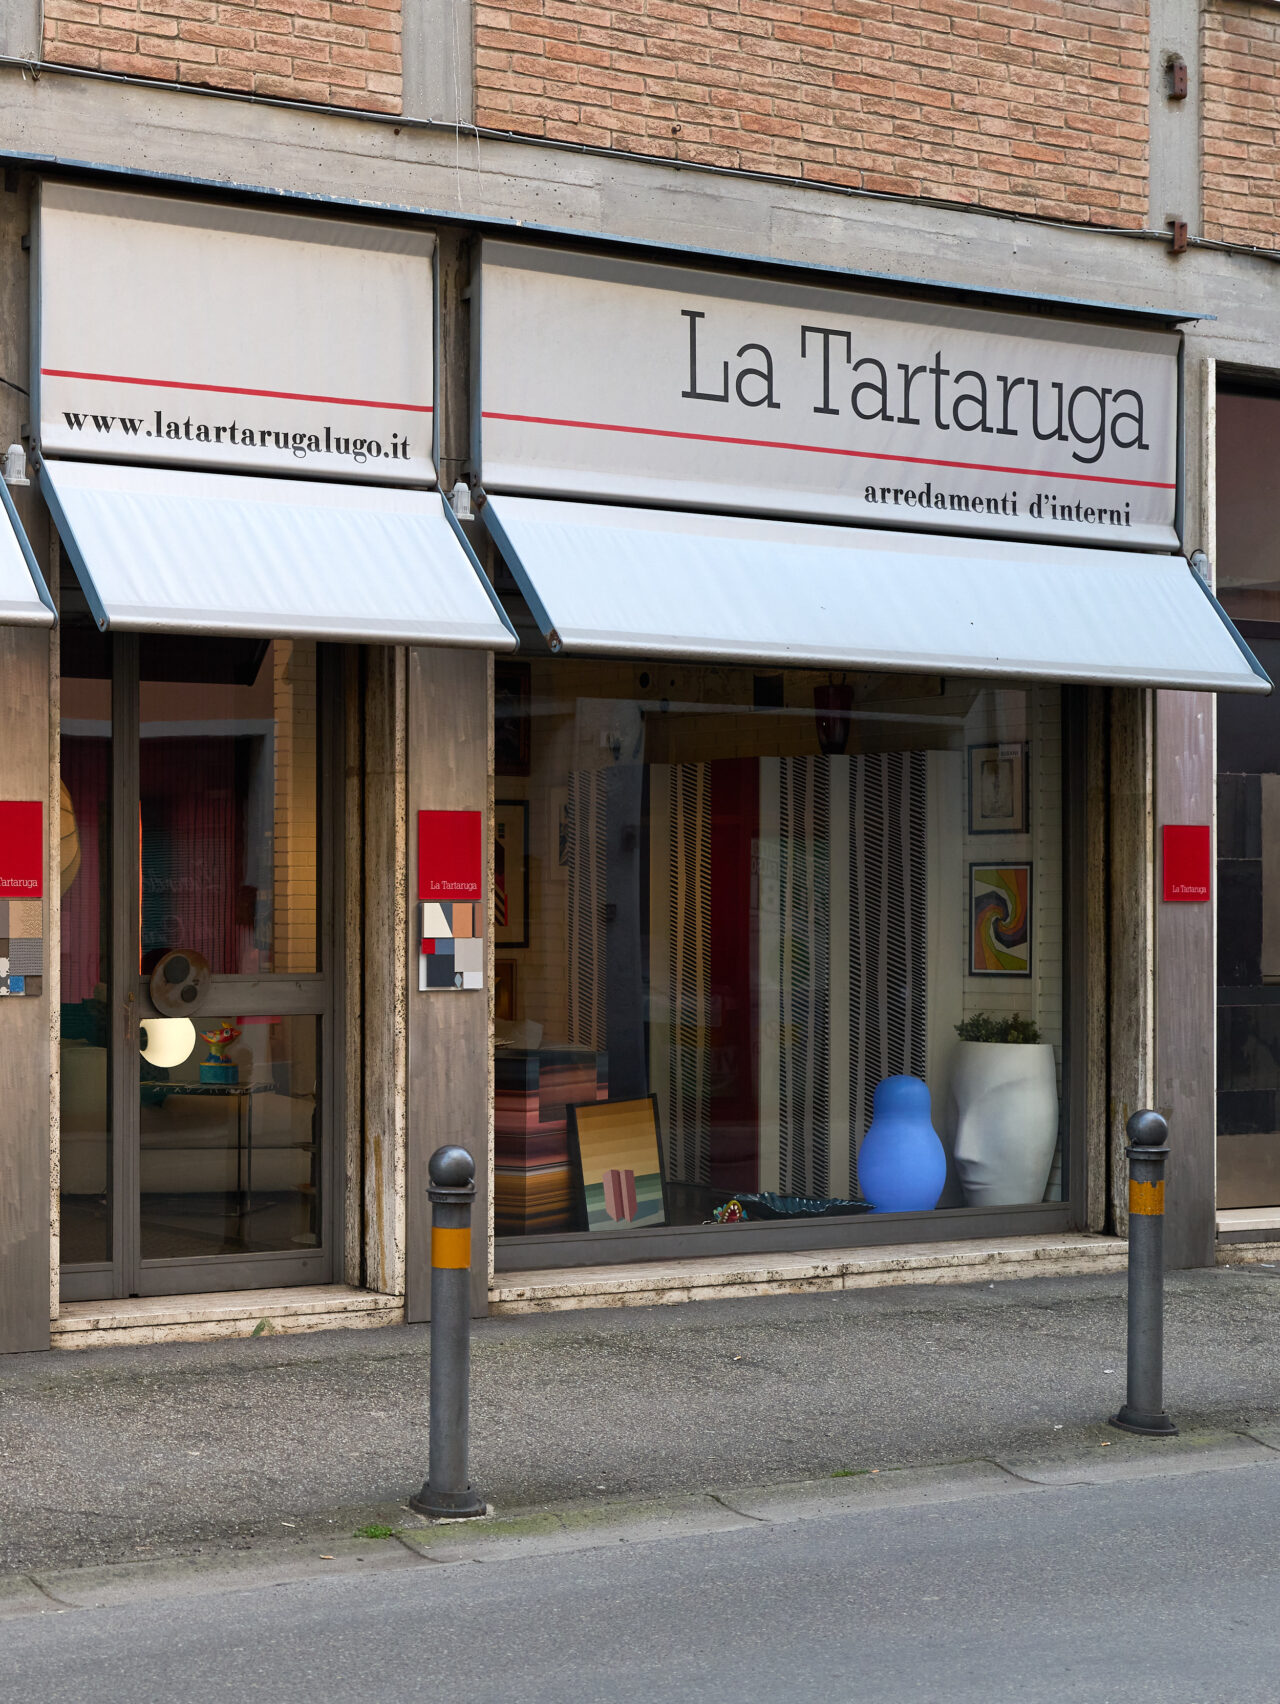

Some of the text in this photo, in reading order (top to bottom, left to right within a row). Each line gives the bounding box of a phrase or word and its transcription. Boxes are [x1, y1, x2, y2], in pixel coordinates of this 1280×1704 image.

[680, 309, 1150, 464] La Tartaruga
[62, 410, 411, 463] www.latartarugalugo.it
[864, 482, 1132, 528] arredamenti d'interni
[430, 880, 477, 892] La Tartaruga
[1172, 884, 1180, 893] La
